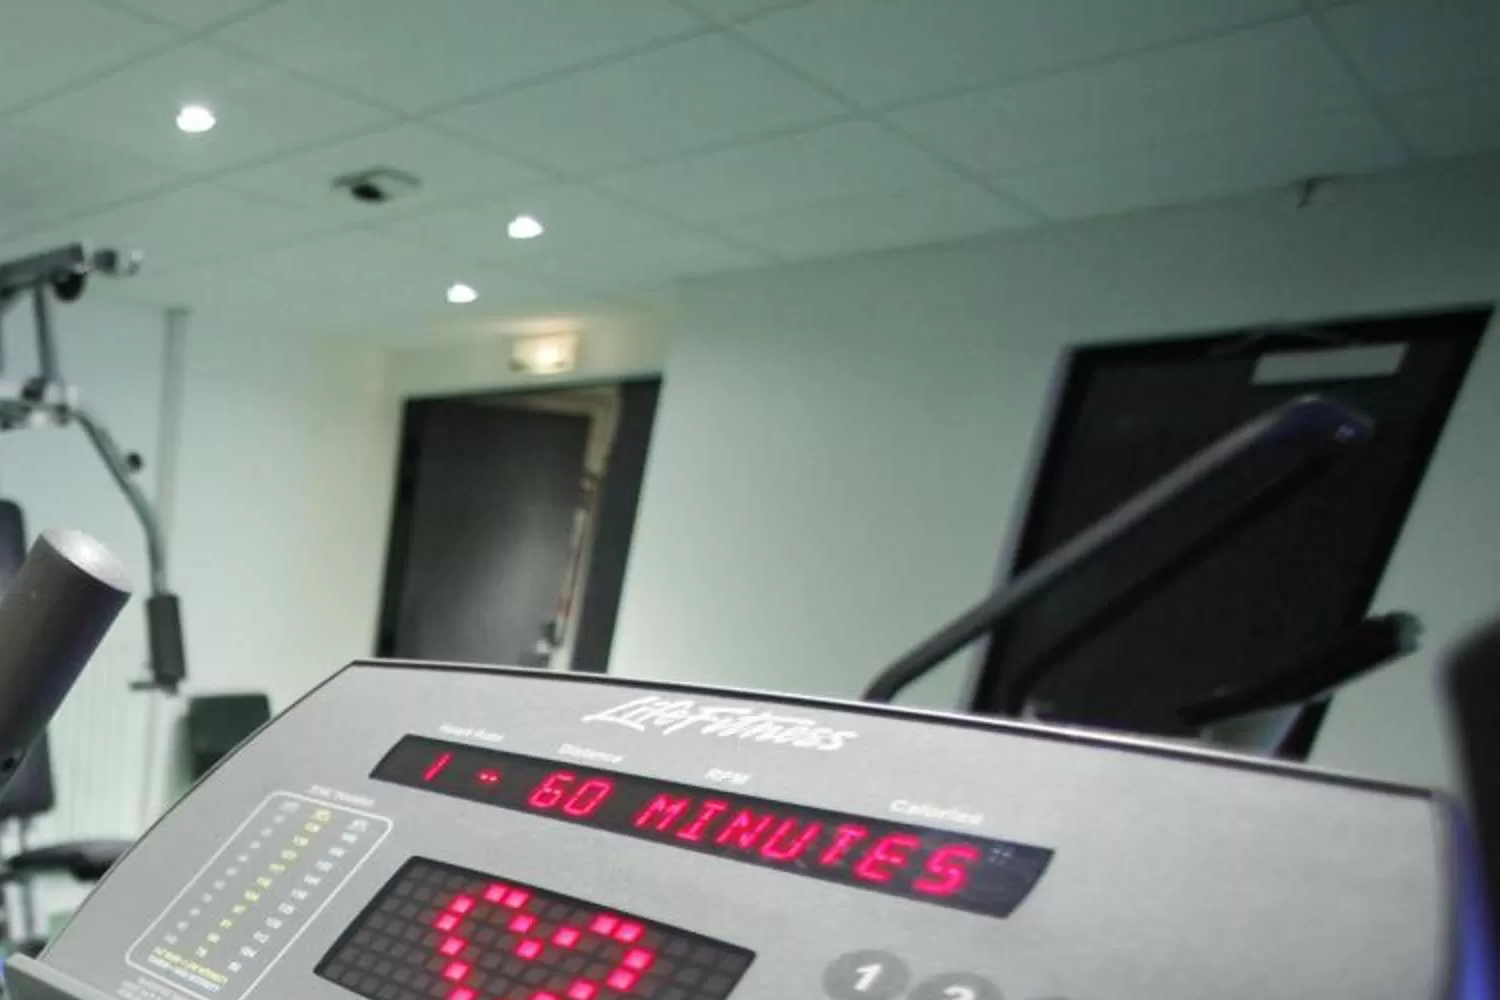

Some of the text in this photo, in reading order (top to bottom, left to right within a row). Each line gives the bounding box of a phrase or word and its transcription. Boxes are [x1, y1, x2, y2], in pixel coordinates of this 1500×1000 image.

[527, 769, 614, 818] 60
[634, 792, 982, 897] MINUTES
[853, 962, 884, 992] 1
